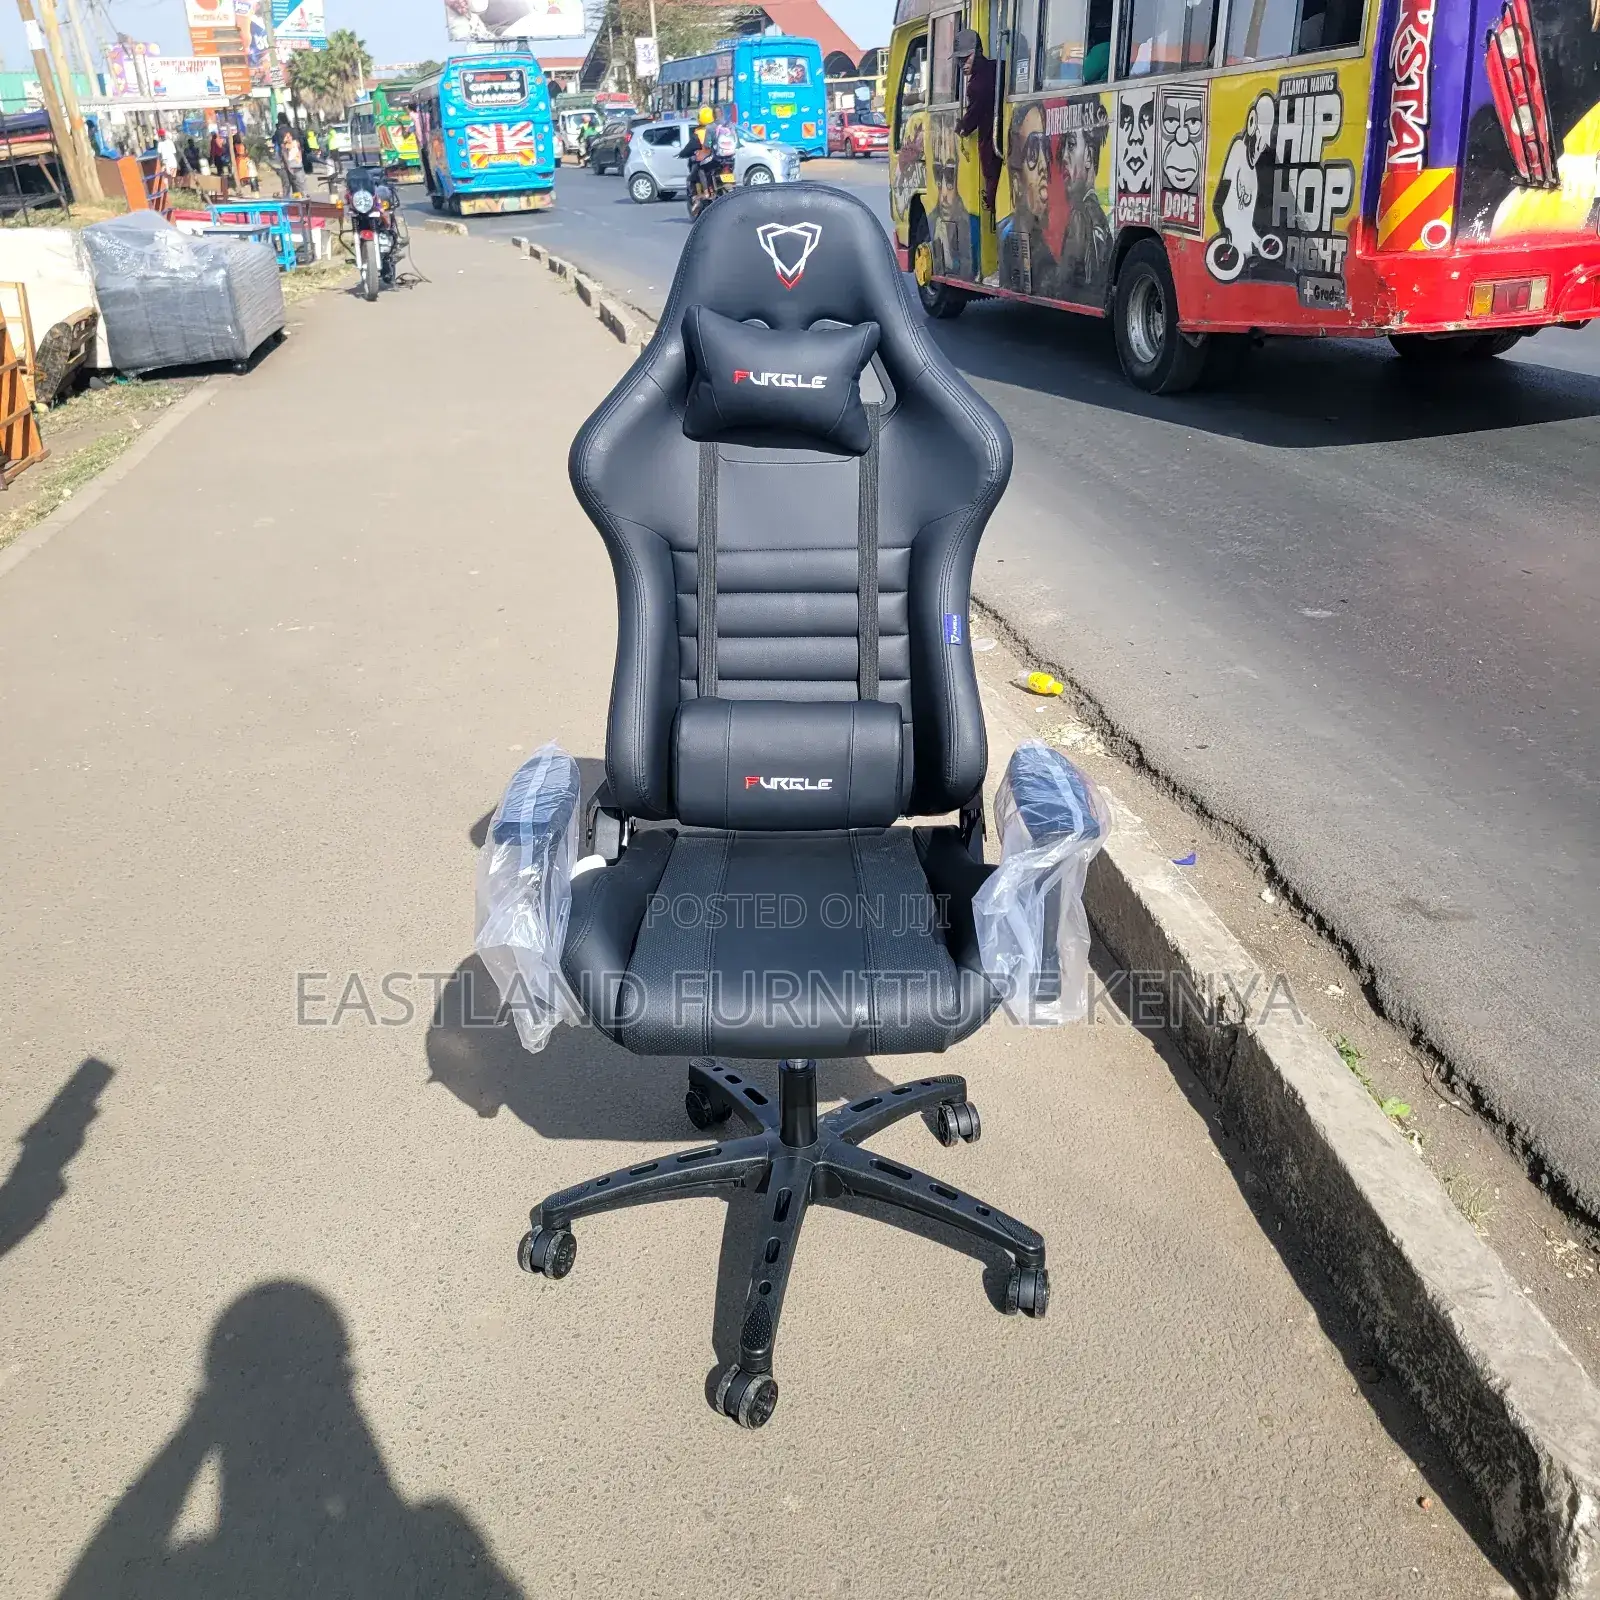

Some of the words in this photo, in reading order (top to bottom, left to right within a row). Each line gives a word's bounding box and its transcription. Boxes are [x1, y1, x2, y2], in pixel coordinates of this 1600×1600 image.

[1280, 79, 1308, 96] ATLANTA
[1310, 75, 1335, 92] HAWKS
[1275, 94, 1341, 163] HIP
[1118, 197, 1150, 222] OBEY
[1164, 191, 1197, 223] DOPE
[1272, 168, 1352, 232] HOP
[732, 370, 828, 389] FURGLE
[744, 776, 833, 791] FURGLE
